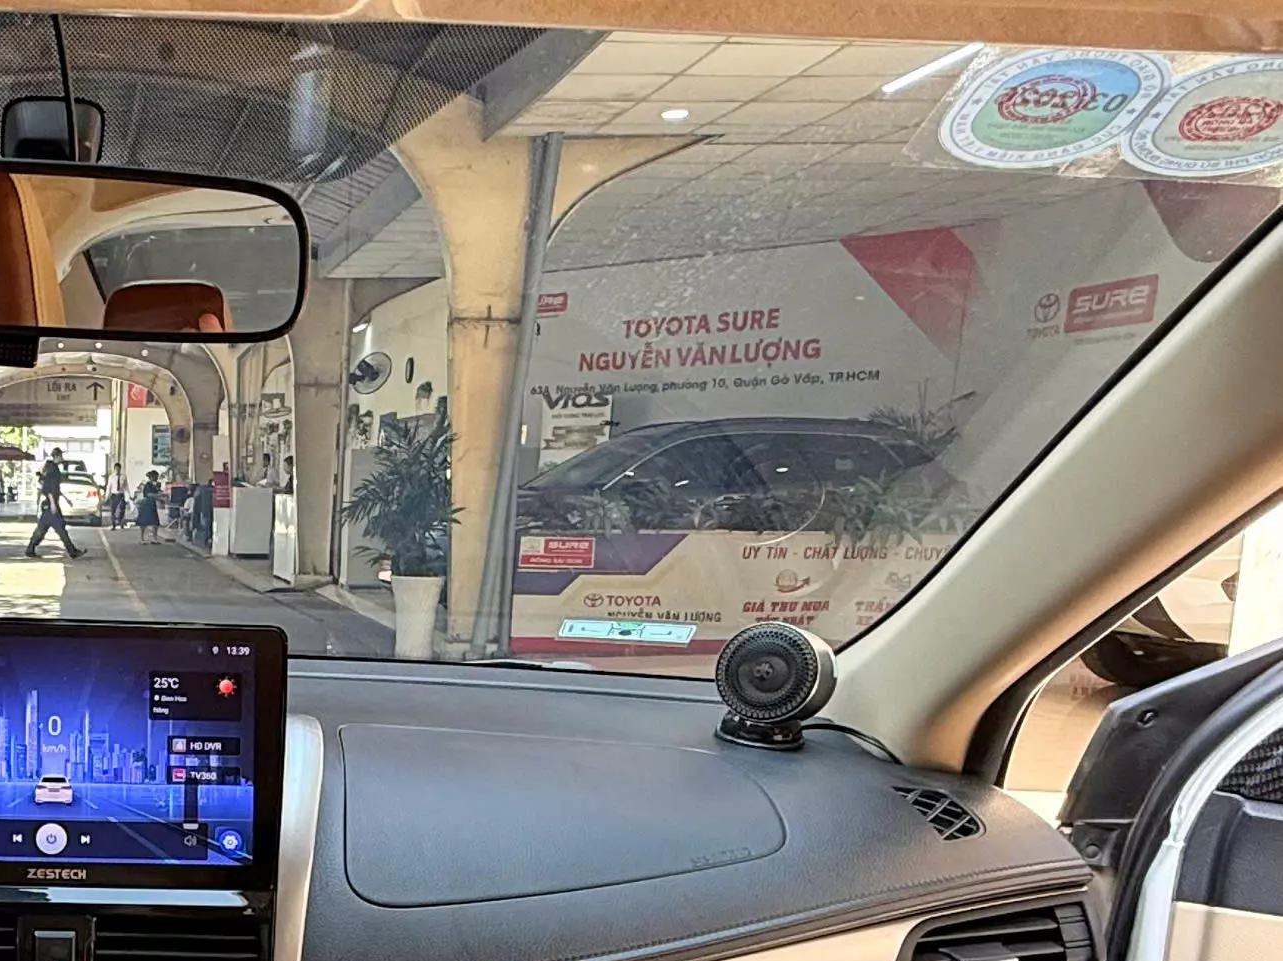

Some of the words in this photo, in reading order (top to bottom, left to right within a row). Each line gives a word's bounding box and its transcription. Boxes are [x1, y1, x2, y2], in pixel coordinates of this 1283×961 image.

[1072, 285, 1150, 315] SURE
[623, 314, 711, 339] TOYOTA
[717, 308, 781, 333] SURE
[578, 341, 671, 372] NGUYỄN
[676, 341, 726, 367] VĂN
[730, 336, 822, 368] LƯỢNG
[742, 546, 760, 560] UY
[766, 544, 788, 560] TÍN
[606, 595, 661, 607] TOYOTA
[742, 600, 766, 613] GIÁ
[770, 600, 799, 613] THU
[801, 600, 830, 612] MUA
[48, 715, 62, 736] 0
[190, 741, 203, 751] HD
[204, 741, 222, 751] DVR
[190, 771, 217, 781] TV360
[26, 868, 87, 880] ZESTECH
